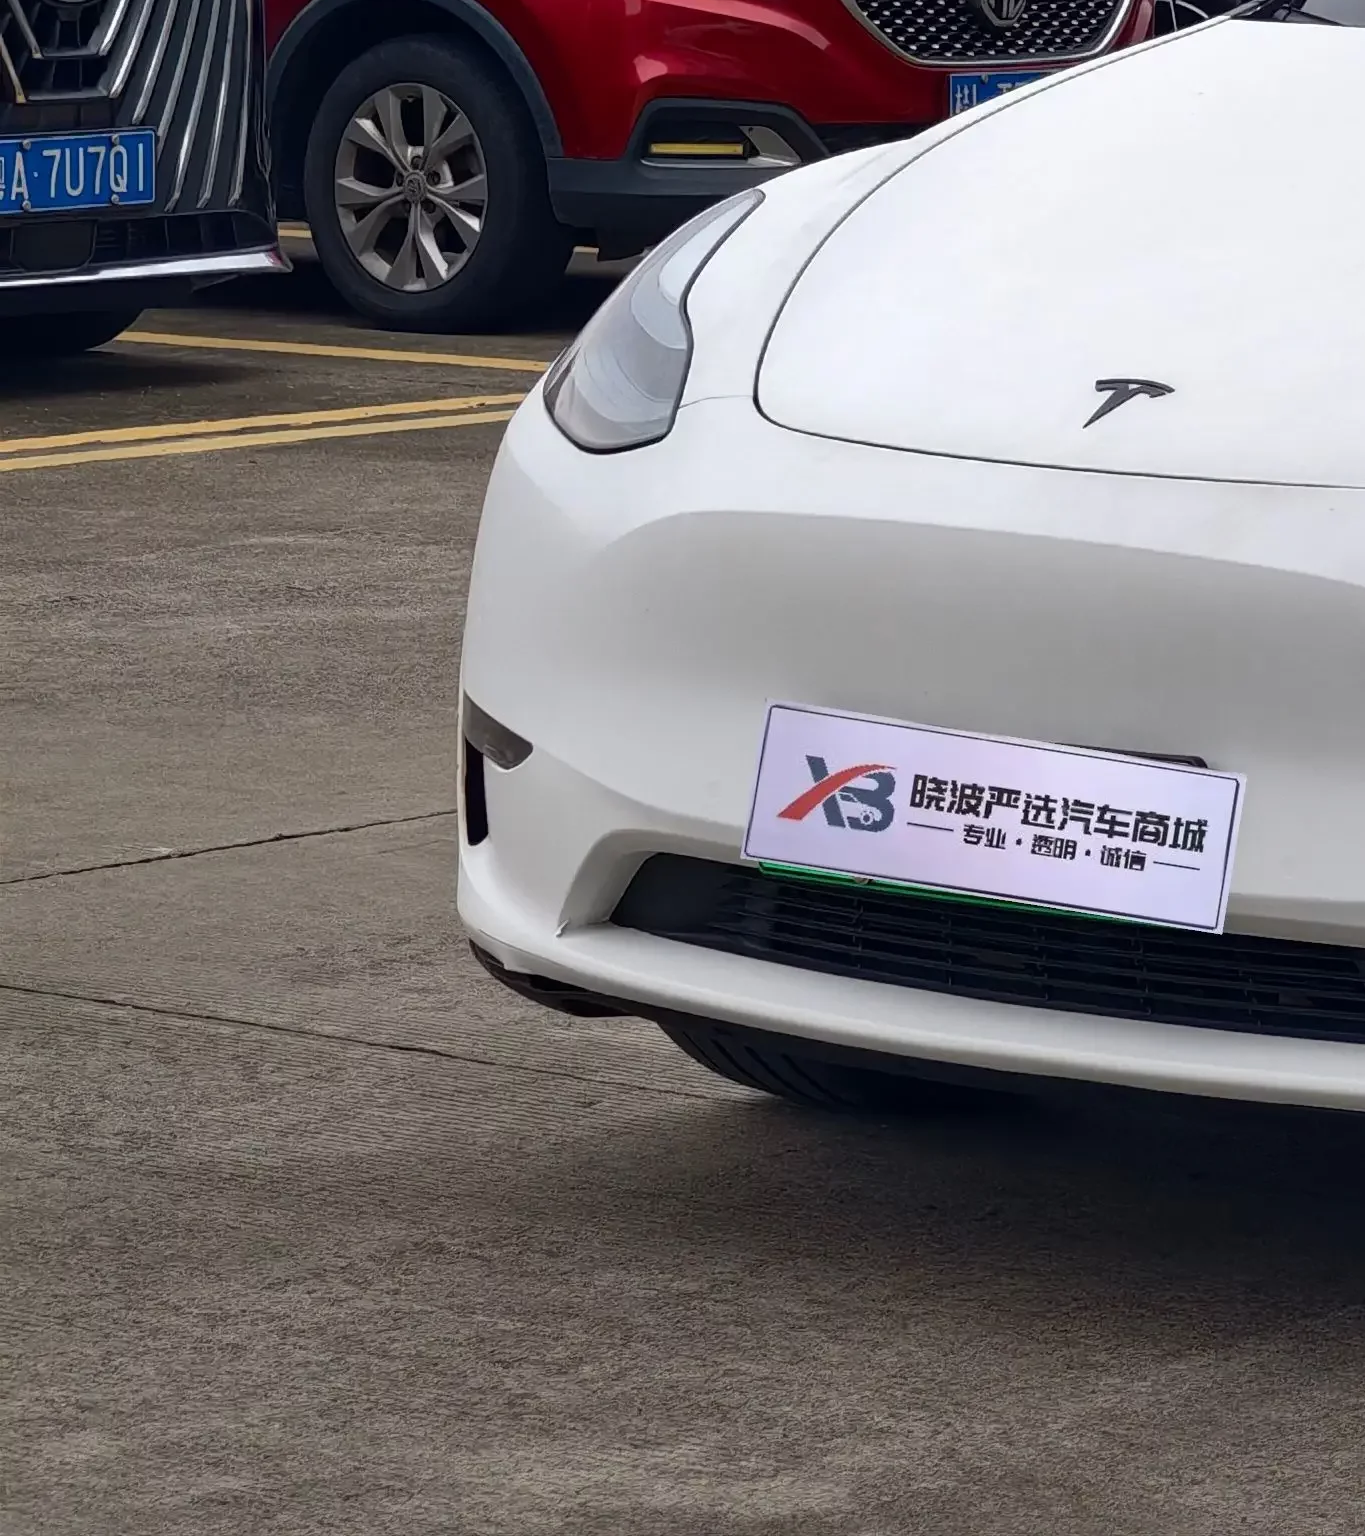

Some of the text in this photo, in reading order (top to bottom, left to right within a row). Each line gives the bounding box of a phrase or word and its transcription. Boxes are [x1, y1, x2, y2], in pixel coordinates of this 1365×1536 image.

[909, 774, 1210, 853] 晓波严选汽车商城
